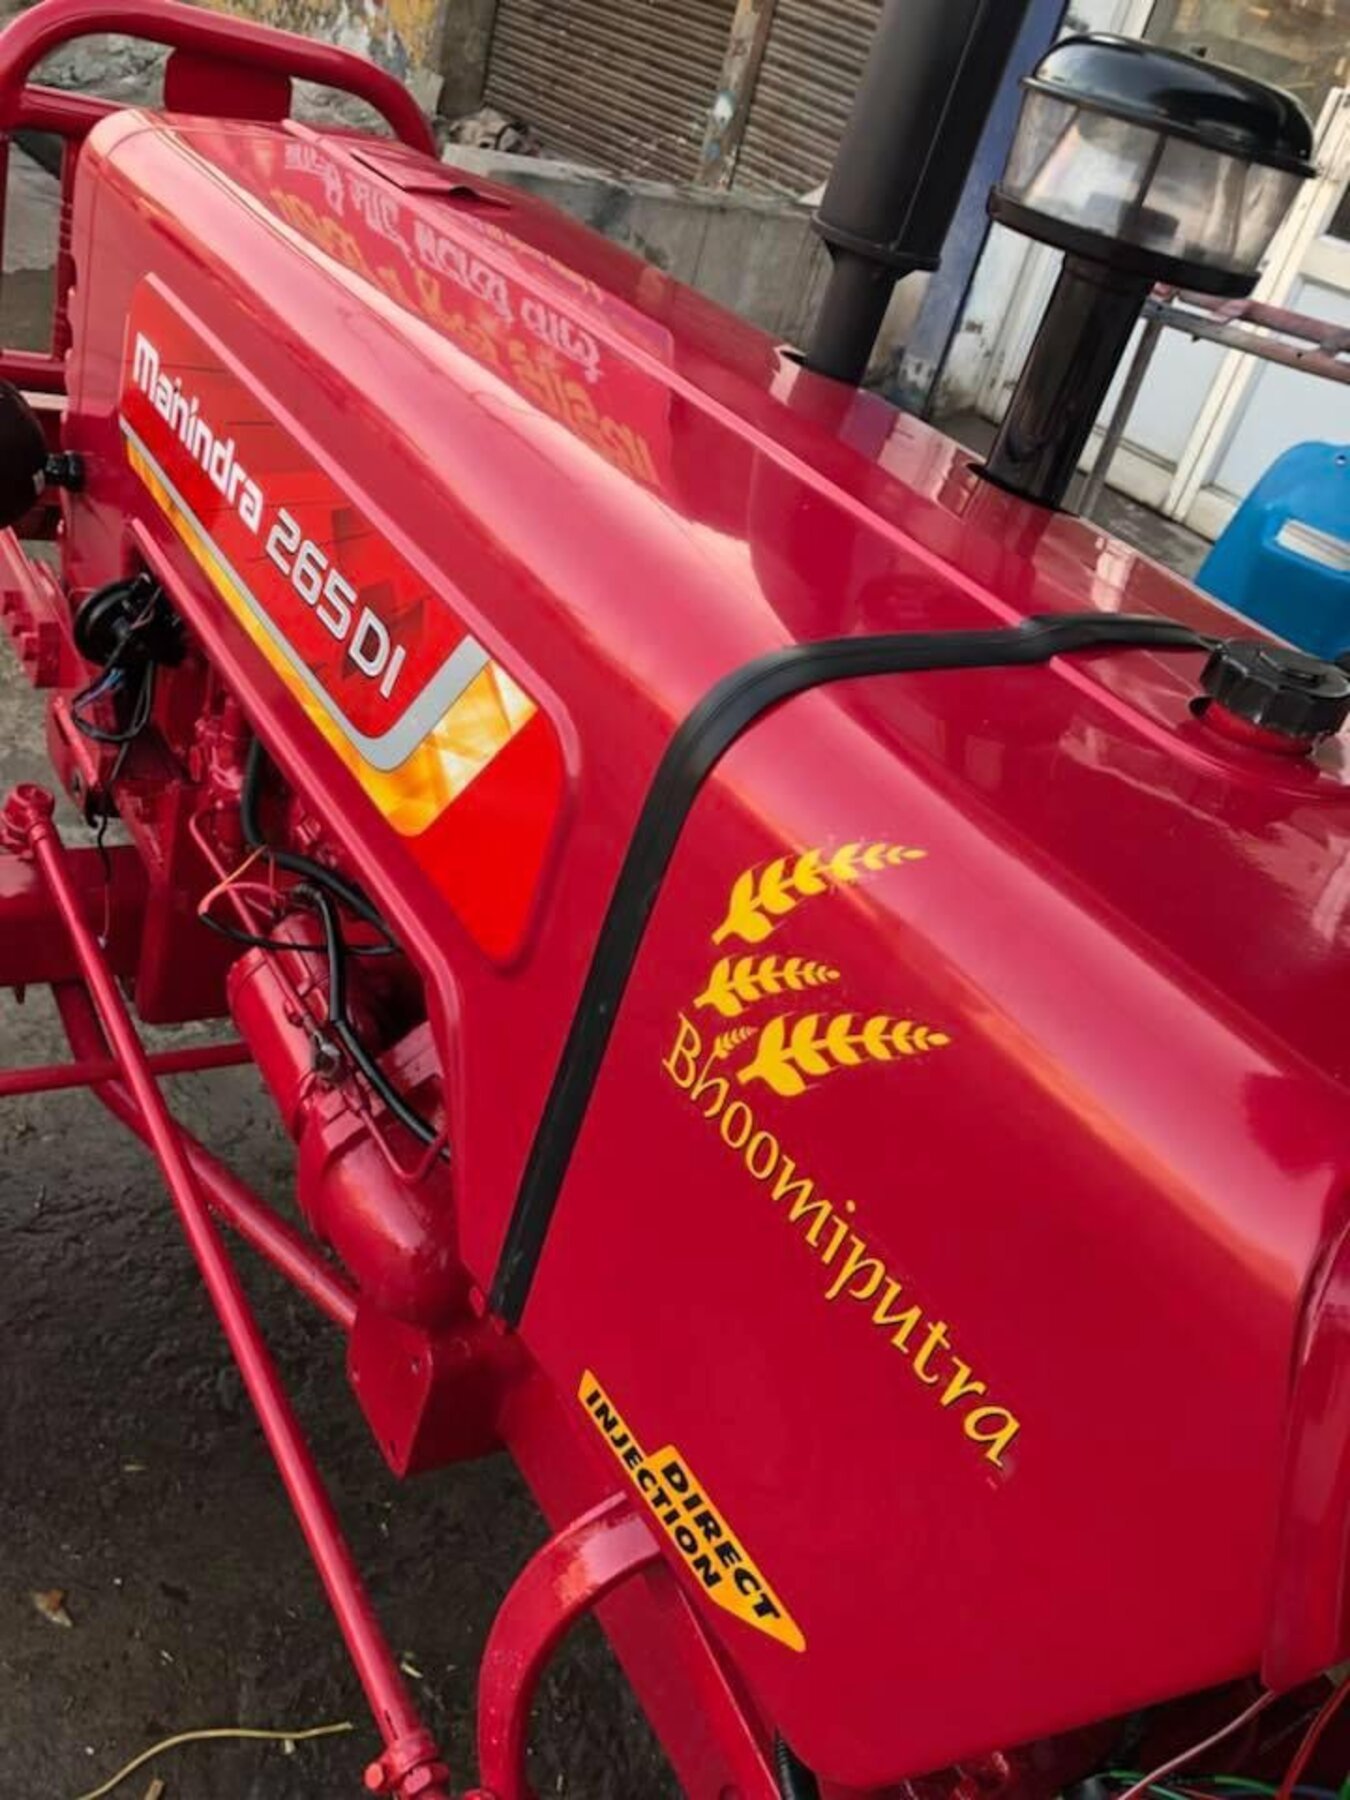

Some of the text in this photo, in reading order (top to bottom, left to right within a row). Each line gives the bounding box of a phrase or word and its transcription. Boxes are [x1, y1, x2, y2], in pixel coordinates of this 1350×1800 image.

[133, 332, 263, 534] Mahindra
[662, 1012, 1021, 1467] Bhoomiputra
[586, 1389, 722, 1588] INJECTION
[661, 1461, 781, 1619] DIRECT
